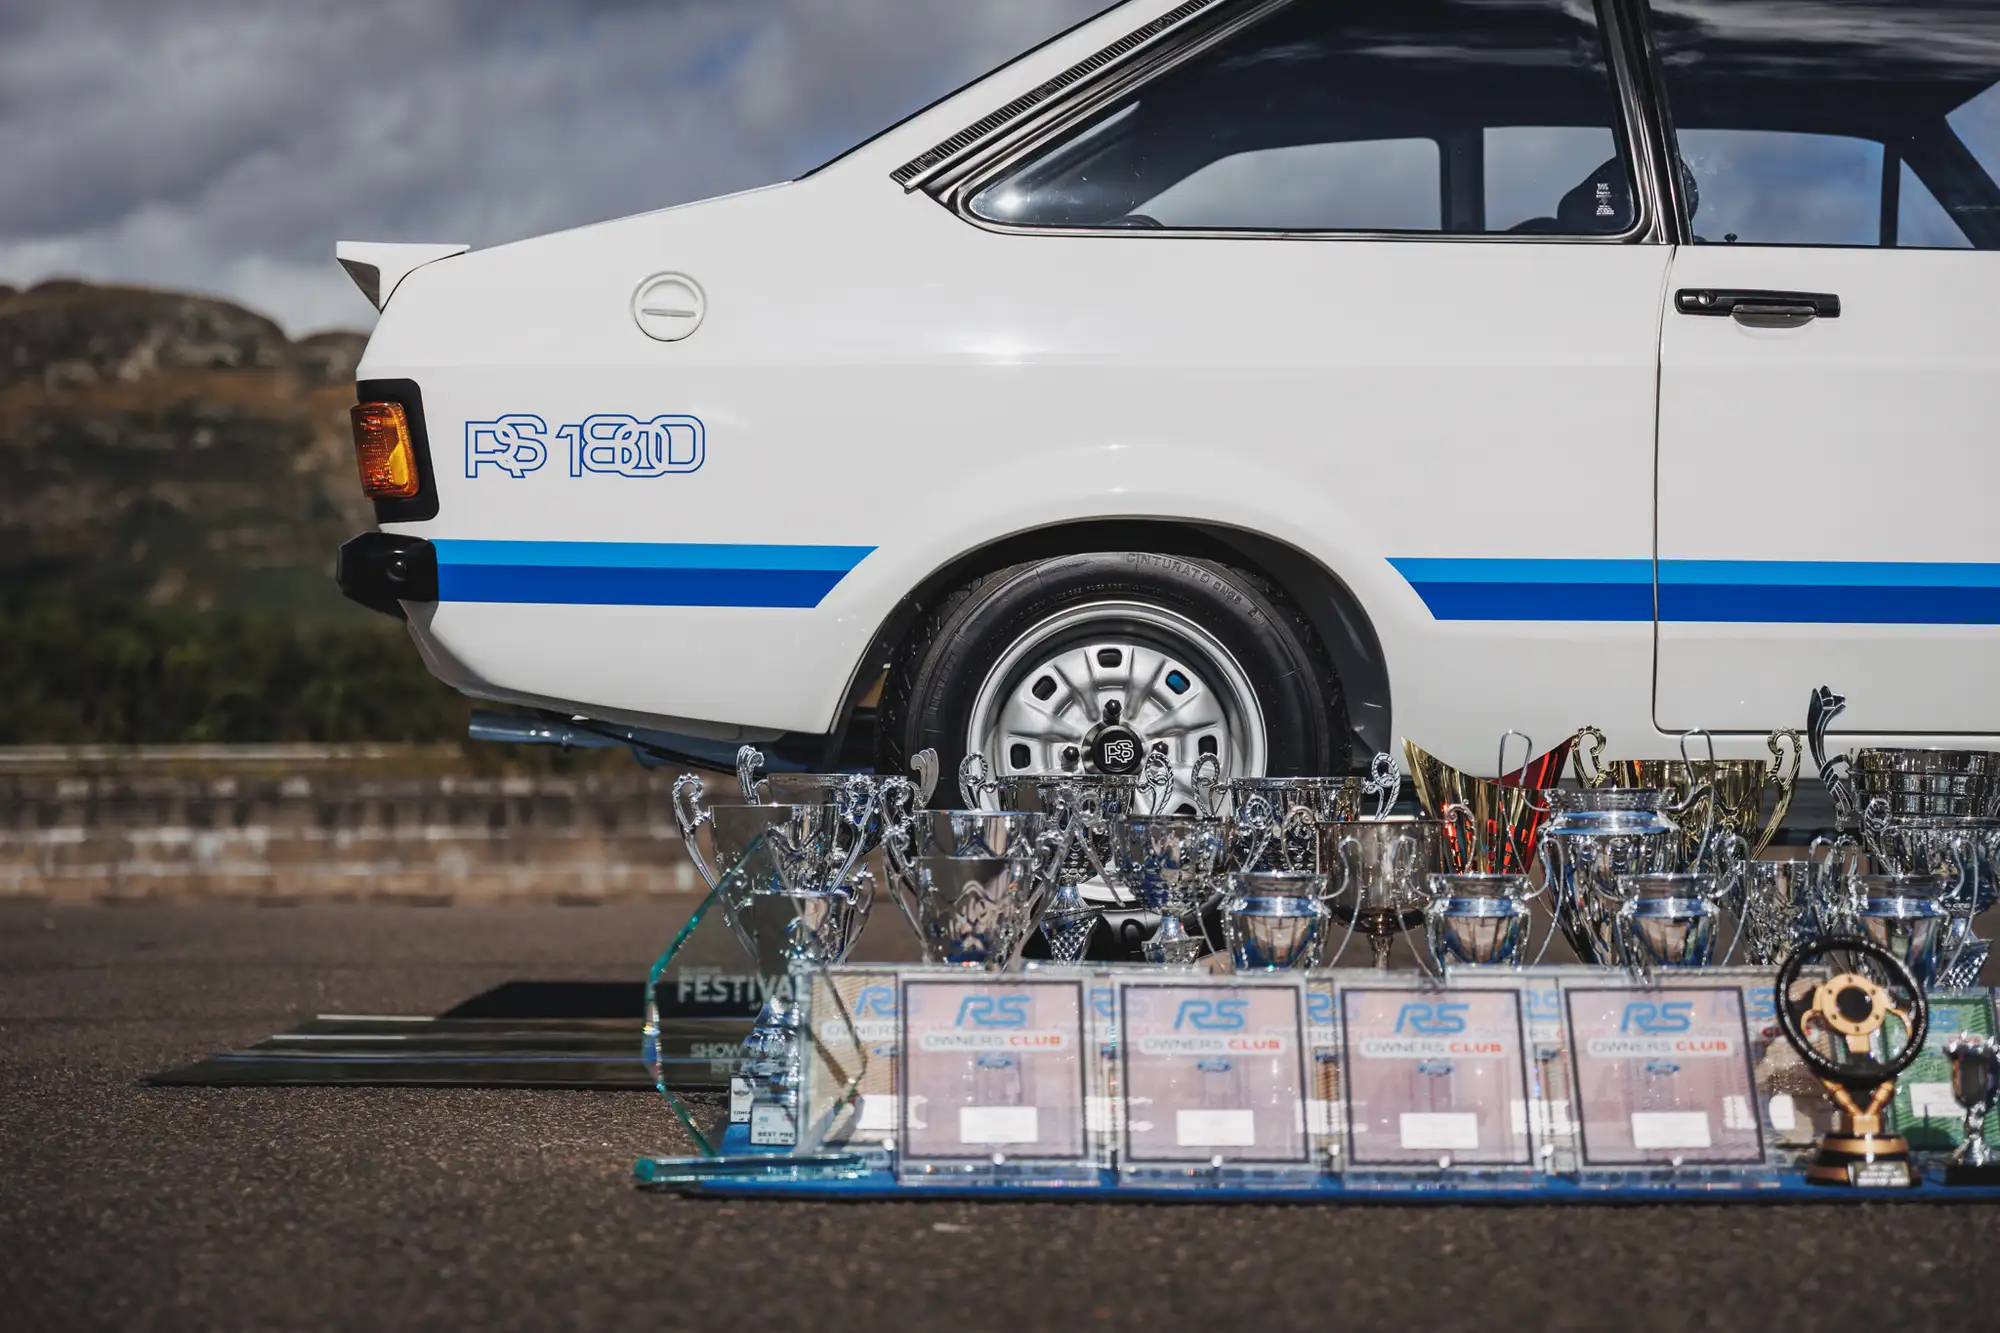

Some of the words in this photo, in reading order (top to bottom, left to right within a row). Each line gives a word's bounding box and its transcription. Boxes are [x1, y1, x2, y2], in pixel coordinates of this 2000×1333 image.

[465, 414, 547, 478] RS
[1125, 552, 1210, 584] CINTURATO
[1104, 740, 1134, 764] RS
[677, 972, 811, 1003] FESTIVAL
[954, 994, 1032, 1027] RS
[1173, 999, 1250, 1030] RS
[1395, 1002, 1470, 1034] RS
[1620, 1001, 1694, 1033] RS
[924, 1035, 1004, 1047] OWNERS
[1009, 1035, 1062, 1047] CLUB
[1144, 1039, 1224, 1049] OWNERS
[1228, 1039, 1280, 1049] CLUB
[1365, 1042, 1444, 1053] OWNERS
[1449, 1042, 1502, 1053] CLUB
[1592, 1041, 1671, 1052] OWNERS
[1676, 1040, 1727, 1051] CLUB
